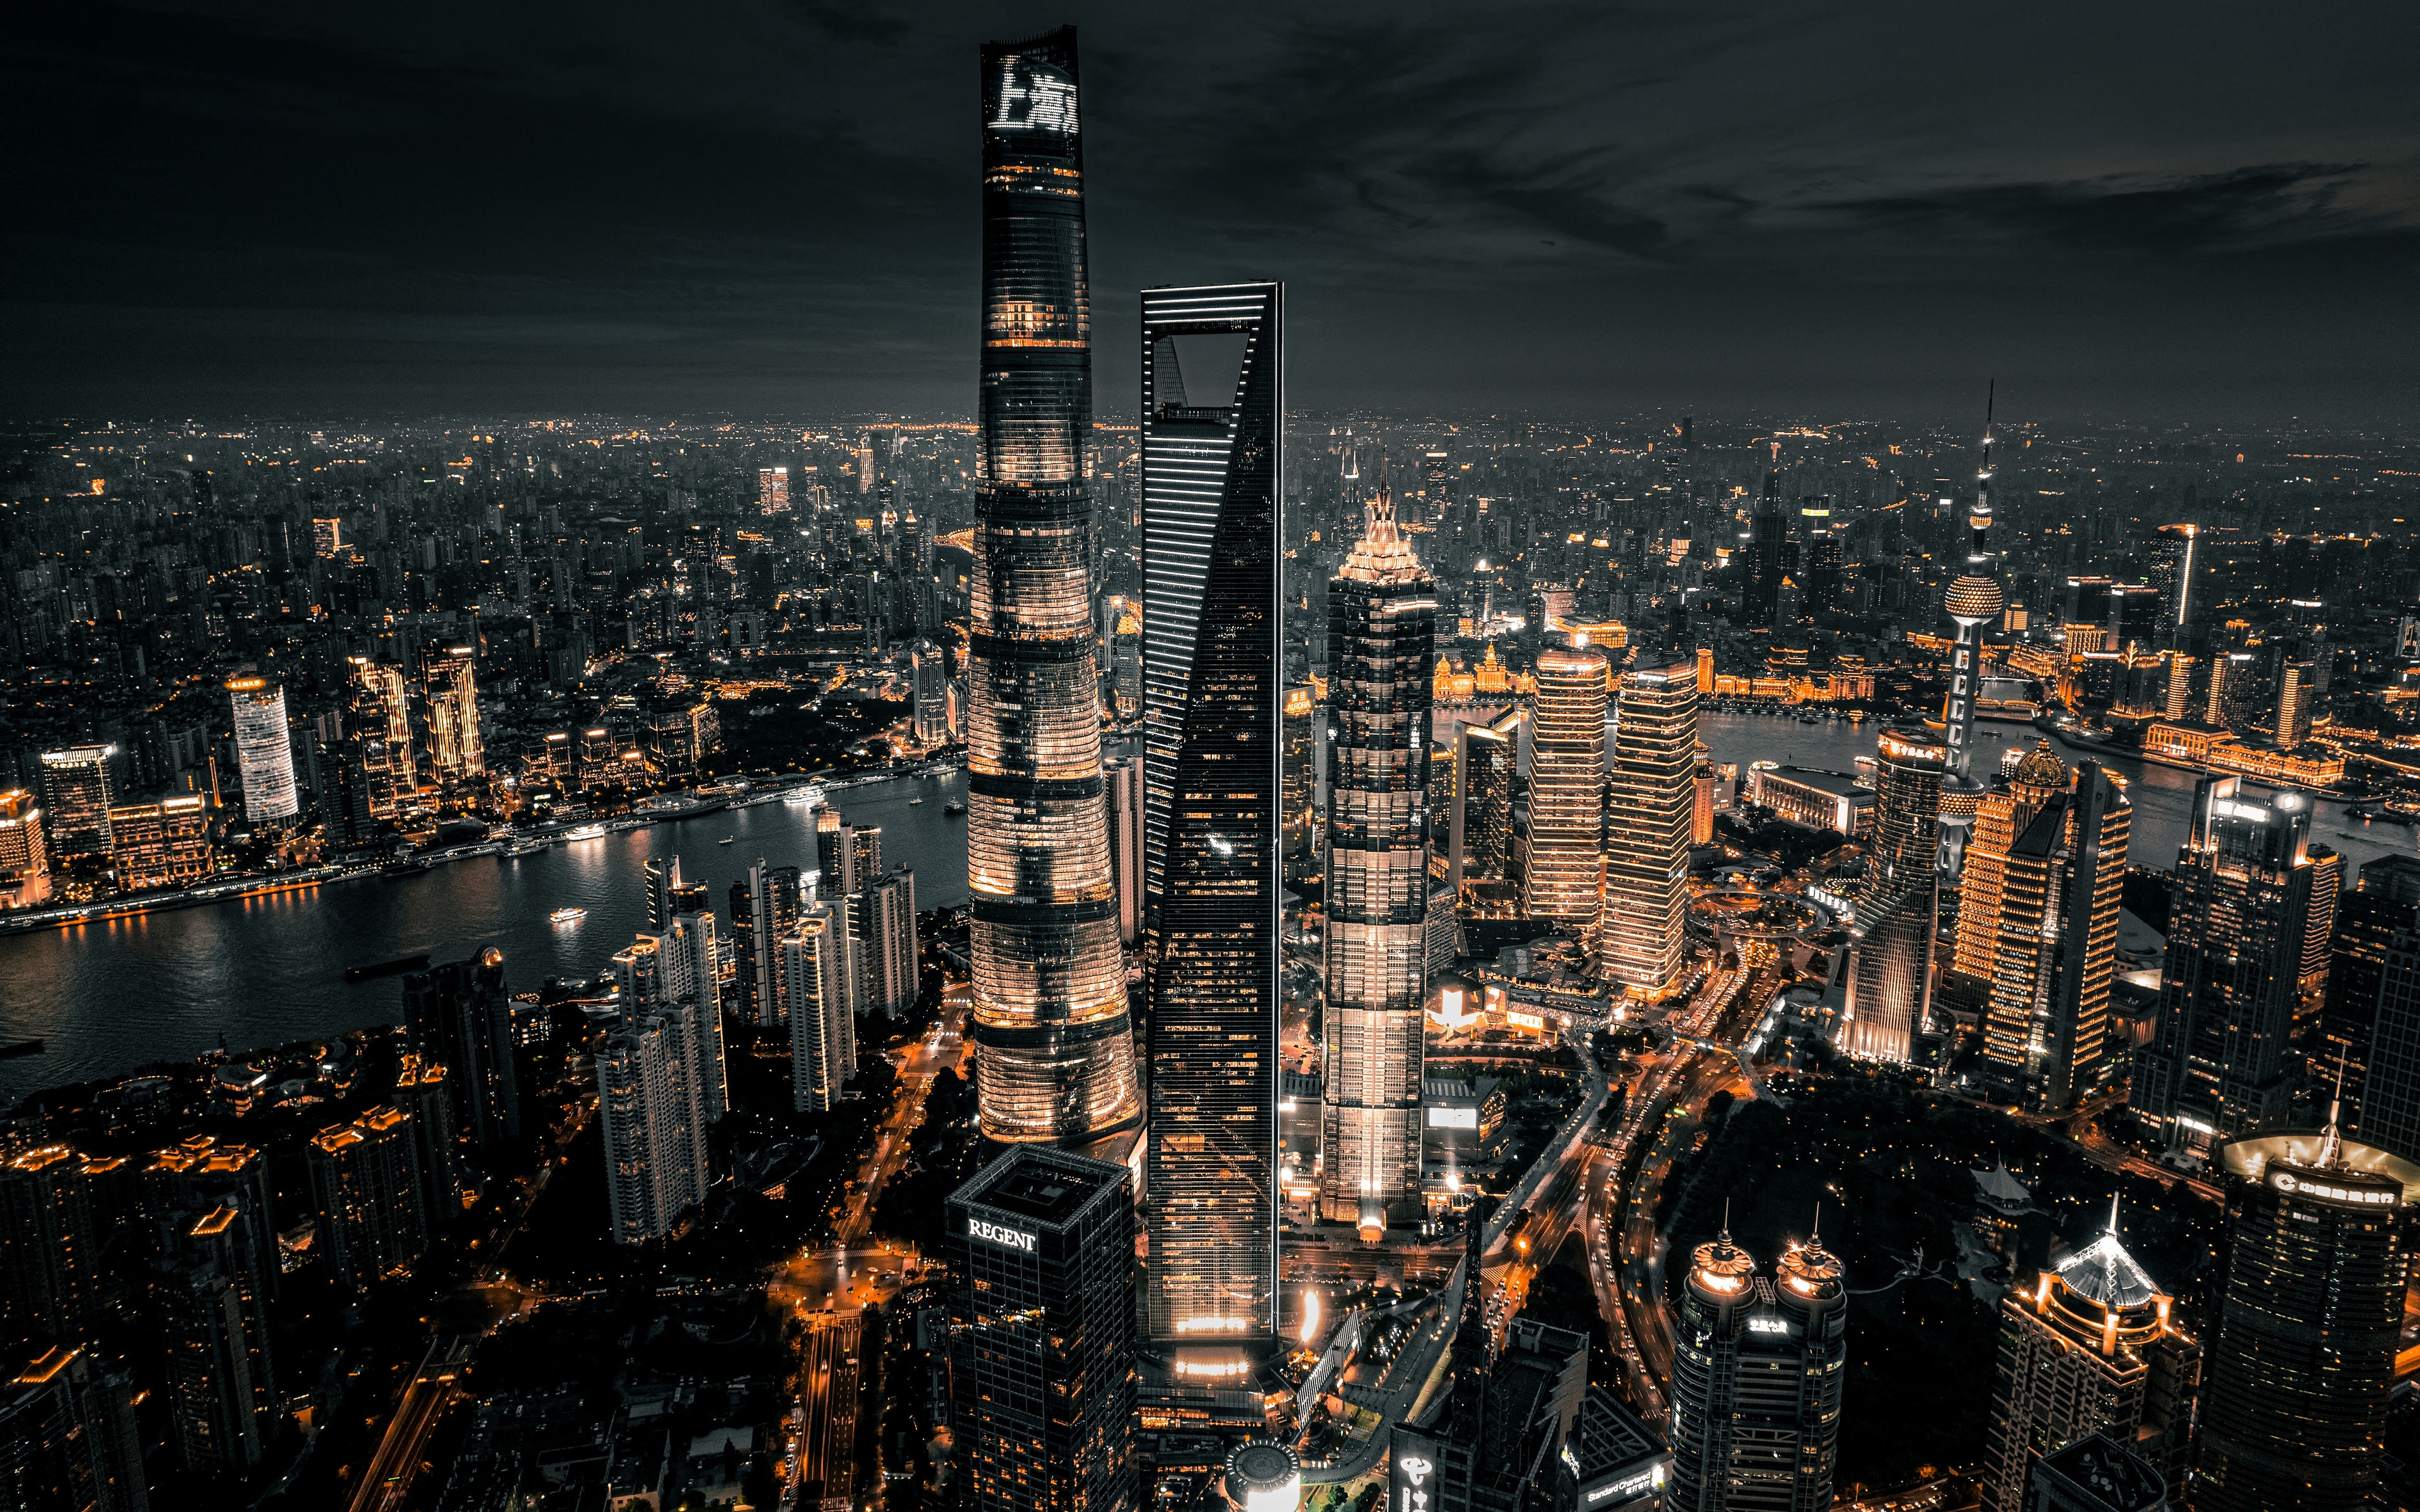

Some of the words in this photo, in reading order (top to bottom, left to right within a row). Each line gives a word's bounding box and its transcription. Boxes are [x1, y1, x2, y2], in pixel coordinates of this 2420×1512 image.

[1287, 701, 1310, 712] AURORA
[1291, 692, 1306, 703] 震旦
[969, 1218, 1035, 1251] REGENT
[1588, 1484, 1618, 1502] Standard
[1618, 1472, 1651, 1489] Chartered
